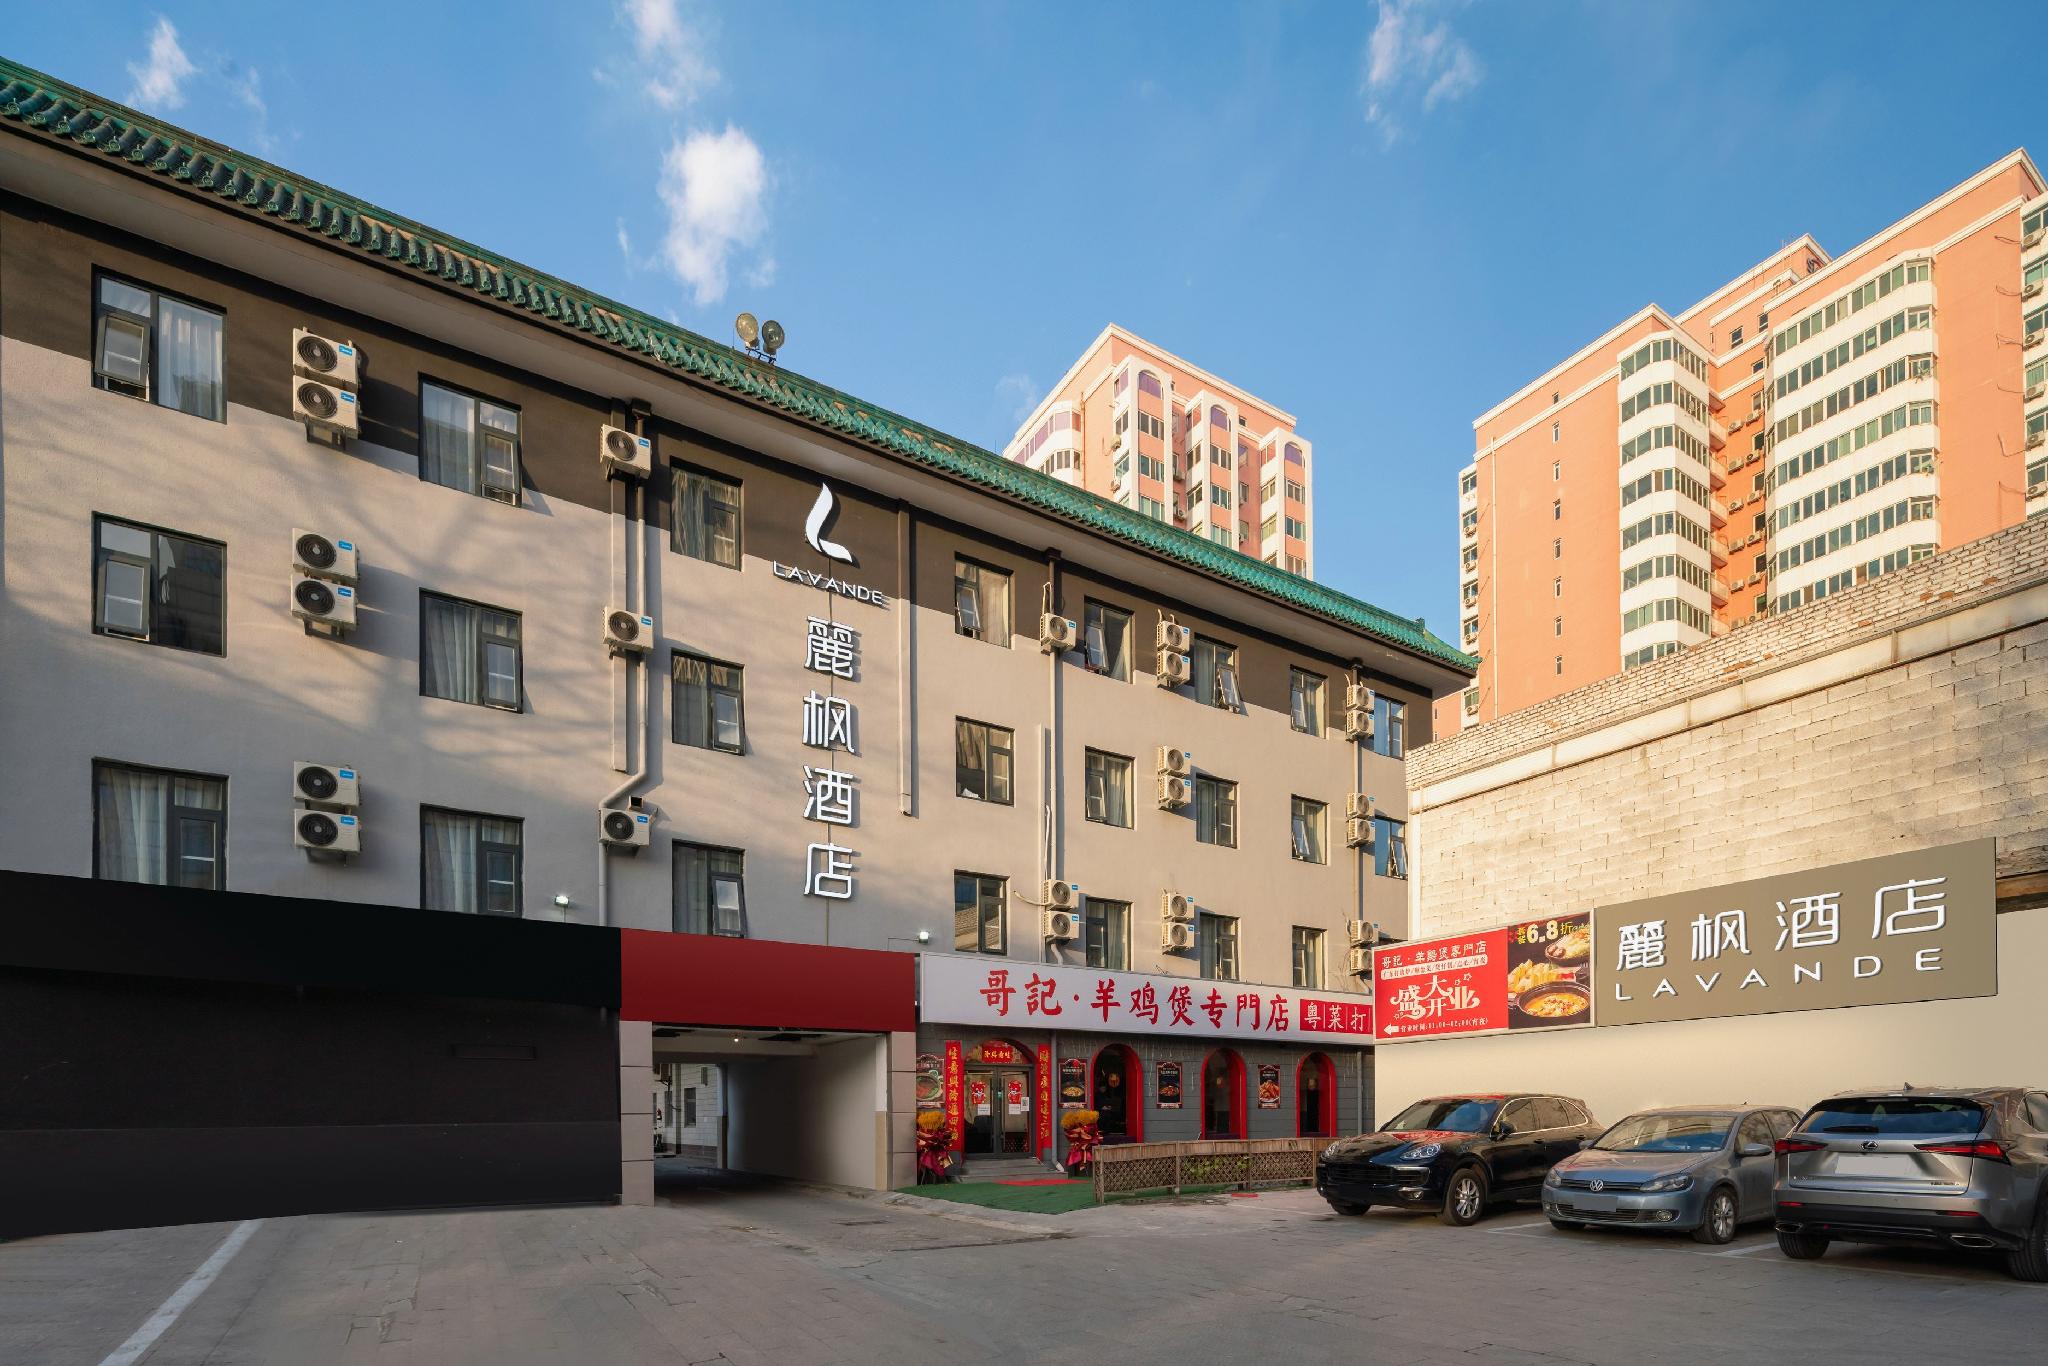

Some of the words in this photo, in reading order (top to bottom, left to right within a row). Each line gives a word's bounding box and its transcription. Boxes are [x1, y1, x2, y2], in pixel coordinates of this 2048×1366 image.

[774, 560, 882, 604] LAVANDE
[803, 615, 855, 899] 麗枫酒店
[1616, 877, 1946, 971] 麗枫酒店
[1615, 947, 1943, 1001] LAVANDE
